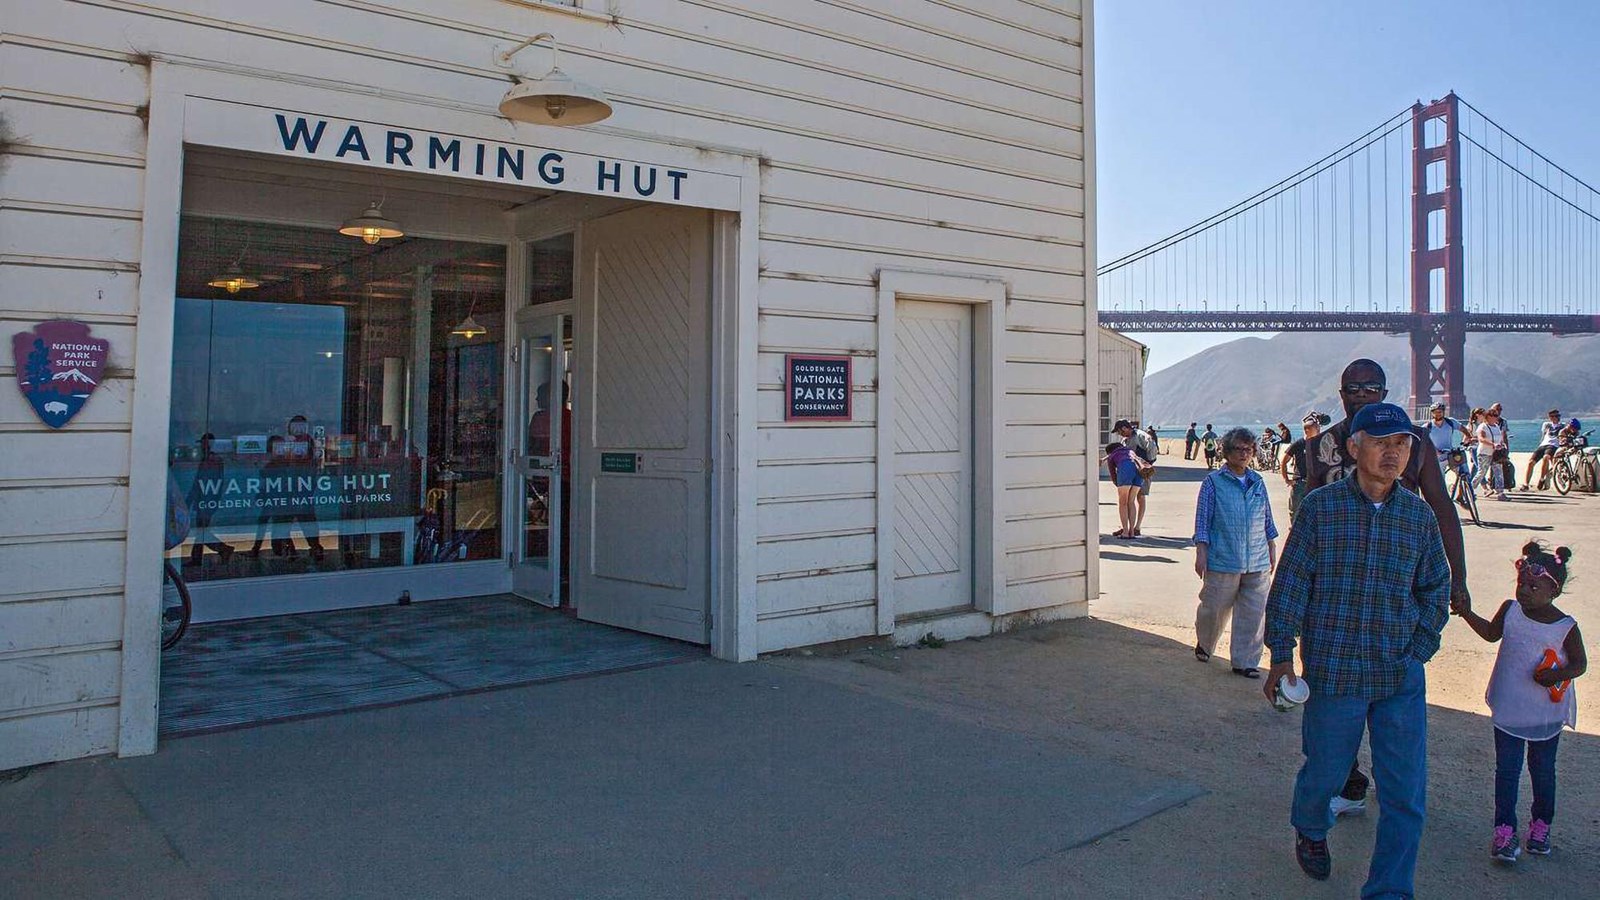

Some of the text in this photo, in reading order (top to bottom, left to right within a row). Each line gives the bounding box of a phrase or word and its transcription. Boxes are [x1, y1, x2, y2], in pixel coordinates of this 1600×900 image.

[275, 113, 688, 200] WARMING HUT
[52, 343, 102, 352] NATIONAL
[795, 375, 844, 384] NATIONAL
[795, 387, 845, 400] PARKS
[198, 474, 391, 496] WARMING HUT
[198, 493, 391, 509] GOLDEN GATE NATIONAL PARKS
